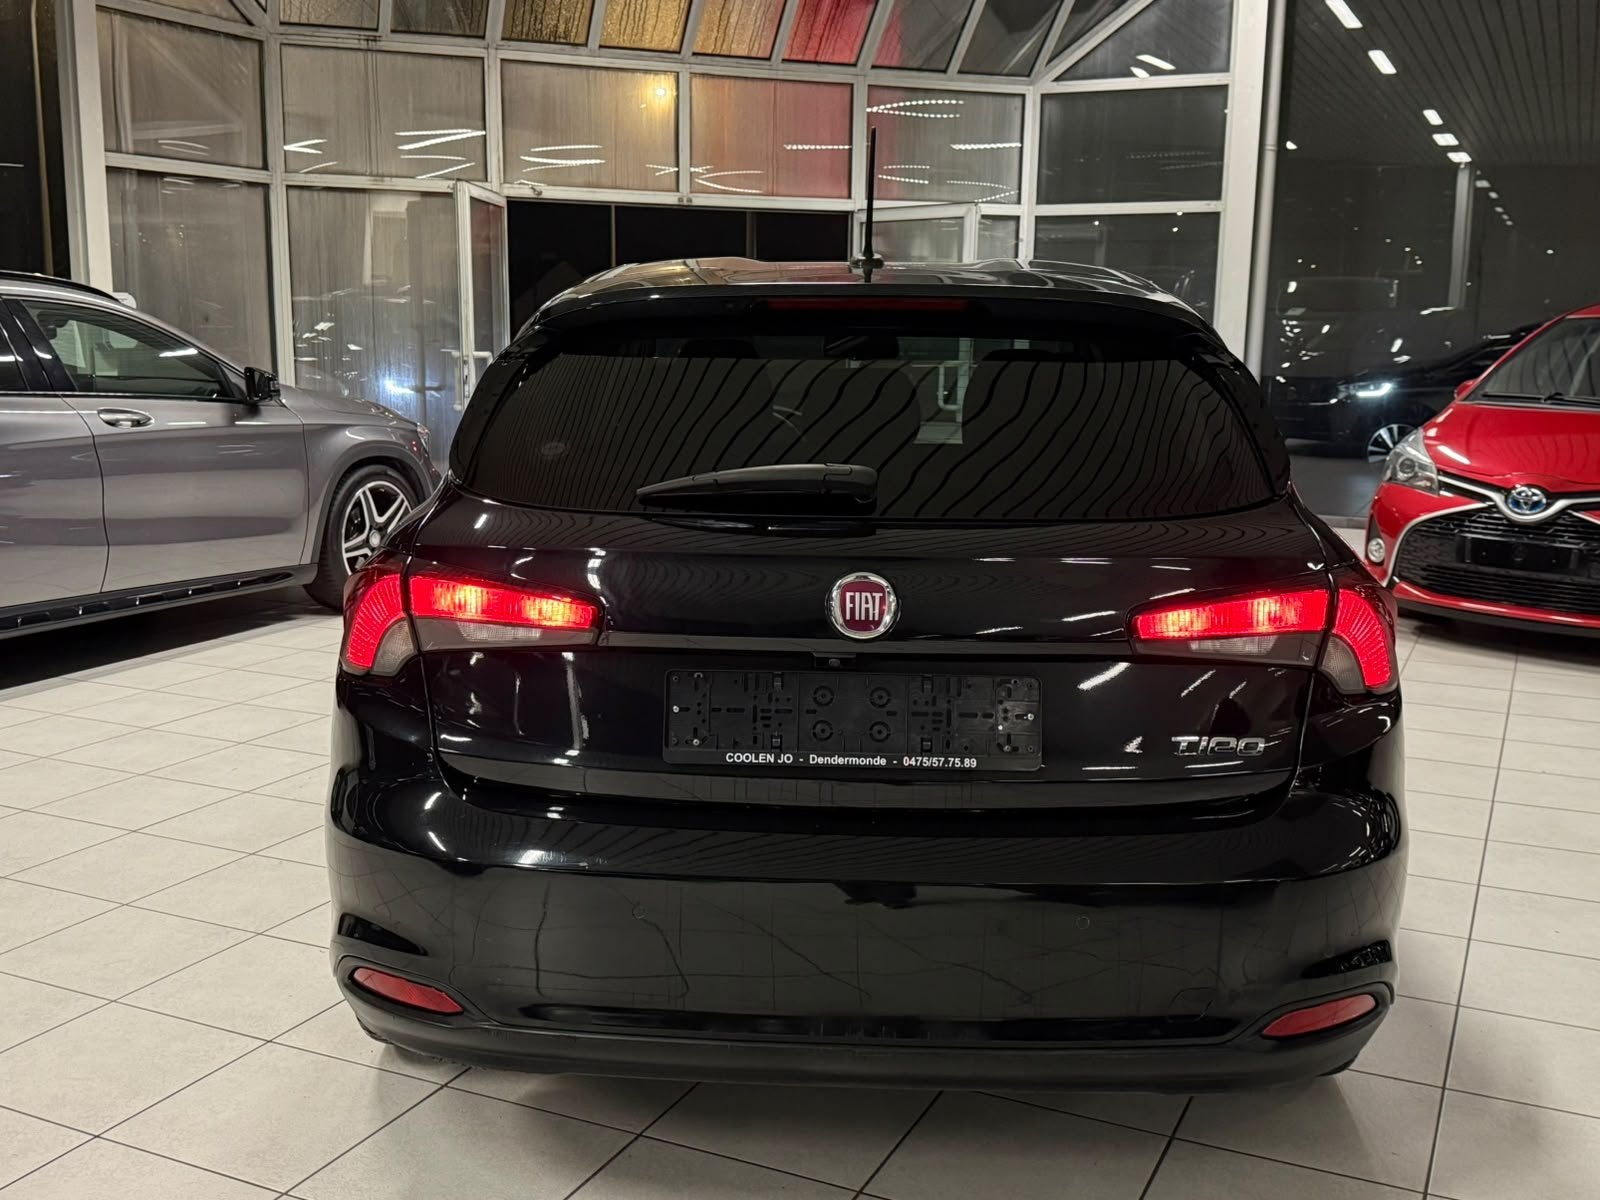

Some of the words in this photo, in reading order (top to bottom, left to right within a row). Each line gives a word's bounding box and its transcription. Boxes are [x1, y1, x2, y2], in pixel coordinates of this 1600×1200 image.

[845, 591, 883, 621] FIAT
[1171, 736, 1266, 756] TIPO
[725, 752, 775, 764] COOLEN
[777, 753, 794, 764] JO
[809, 754, 887, 766] Dendermonde
[902, 756, 978, 769] 0475/57.75.89
